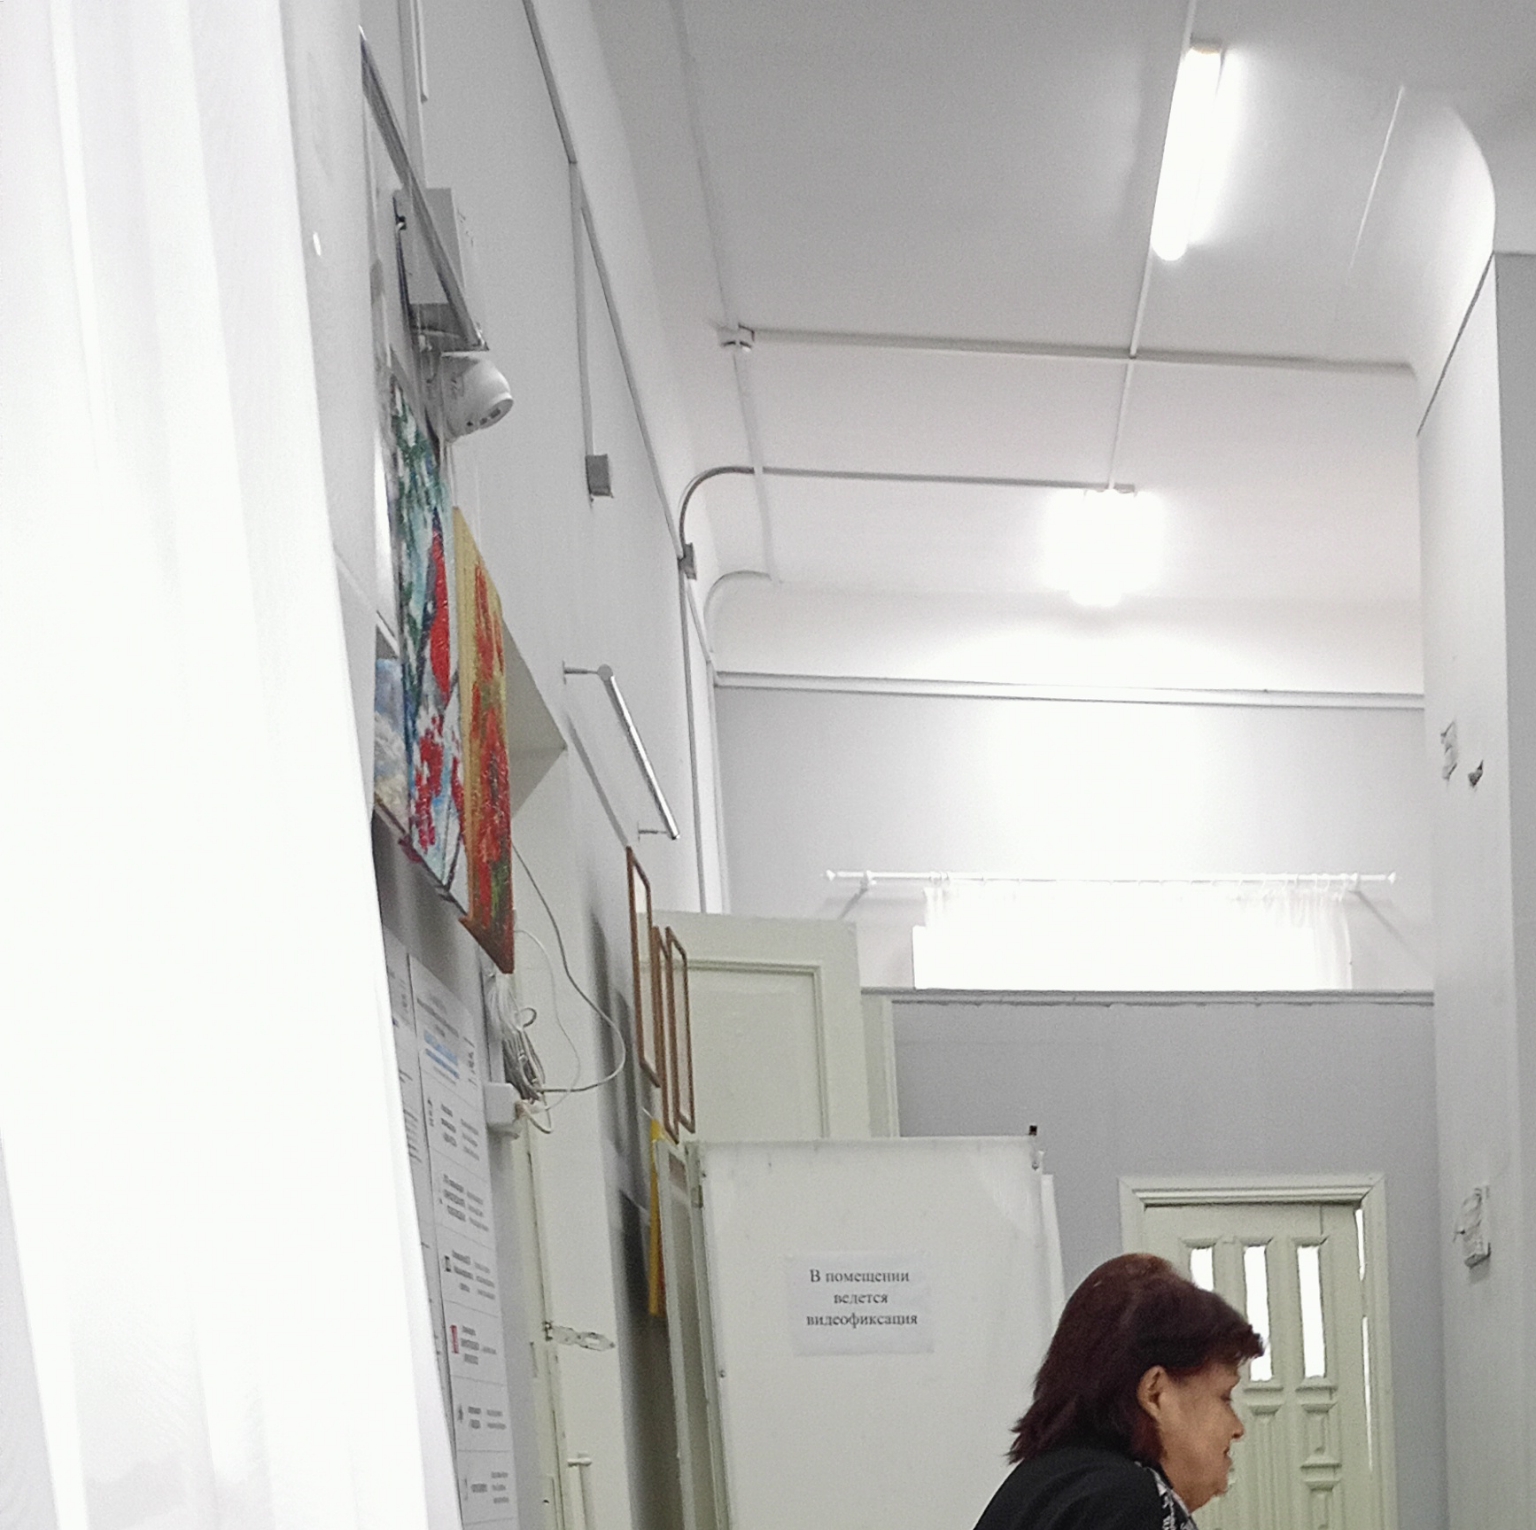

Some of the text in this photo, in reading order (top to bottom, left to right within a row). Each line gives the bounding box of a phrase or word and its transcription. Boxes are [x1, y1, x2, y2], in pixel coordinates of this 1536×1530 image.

[810, 1268, 910, 1283] В помещении
[833, 1293, 888, 1305] ведется
[806, 1312, 918, 1329] видеофиксация
